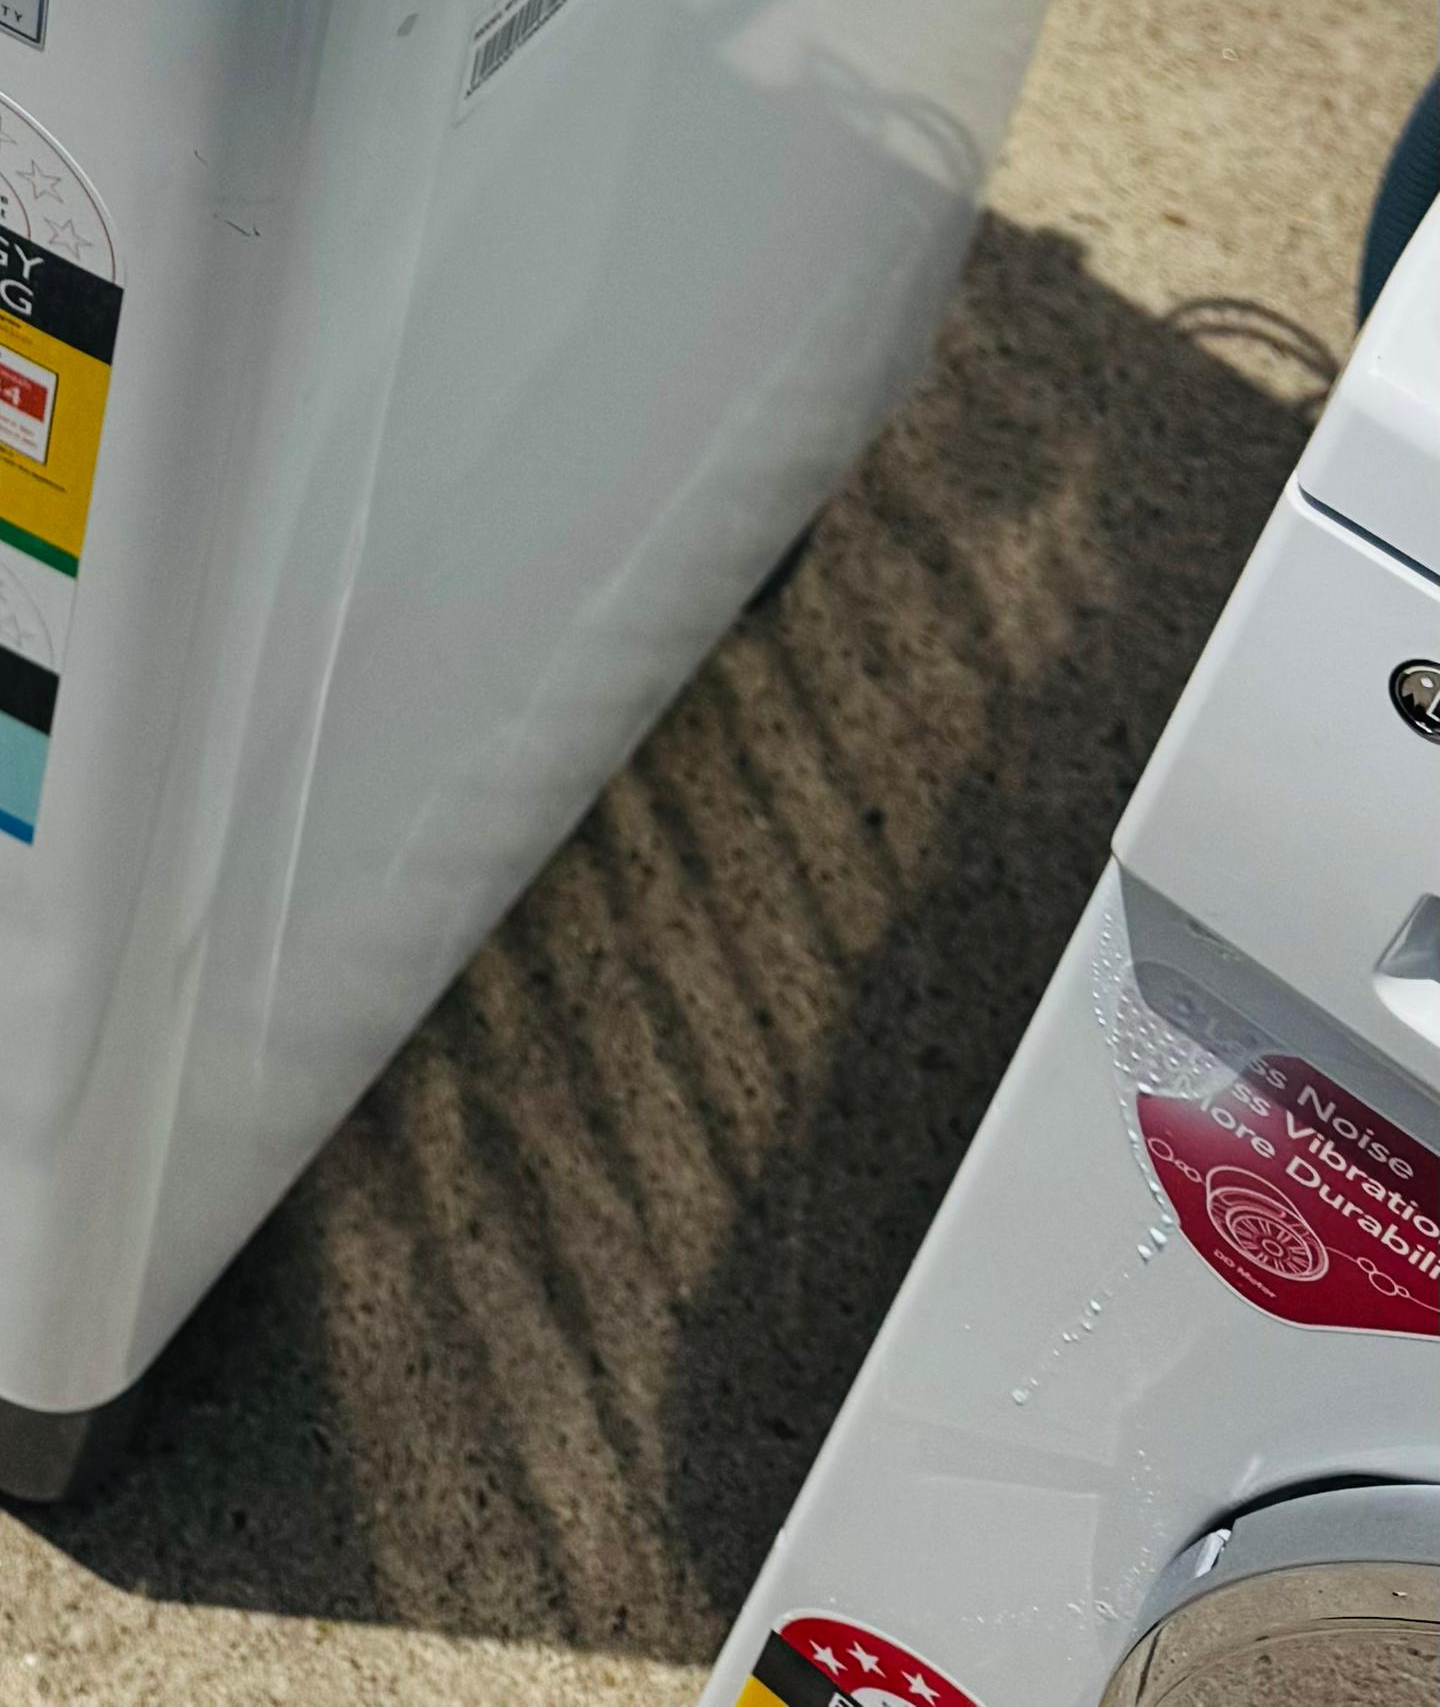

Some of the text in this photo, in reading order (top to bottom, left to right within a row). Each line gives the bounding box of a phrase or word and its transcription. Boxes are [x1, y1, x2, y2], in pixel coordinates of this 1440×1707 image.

[1285, 1109, 1440, 1247] Vibratio
[1296, 1084, 1415, 1181] Noise
[1235, 1264, 1279, 1298] Motor
